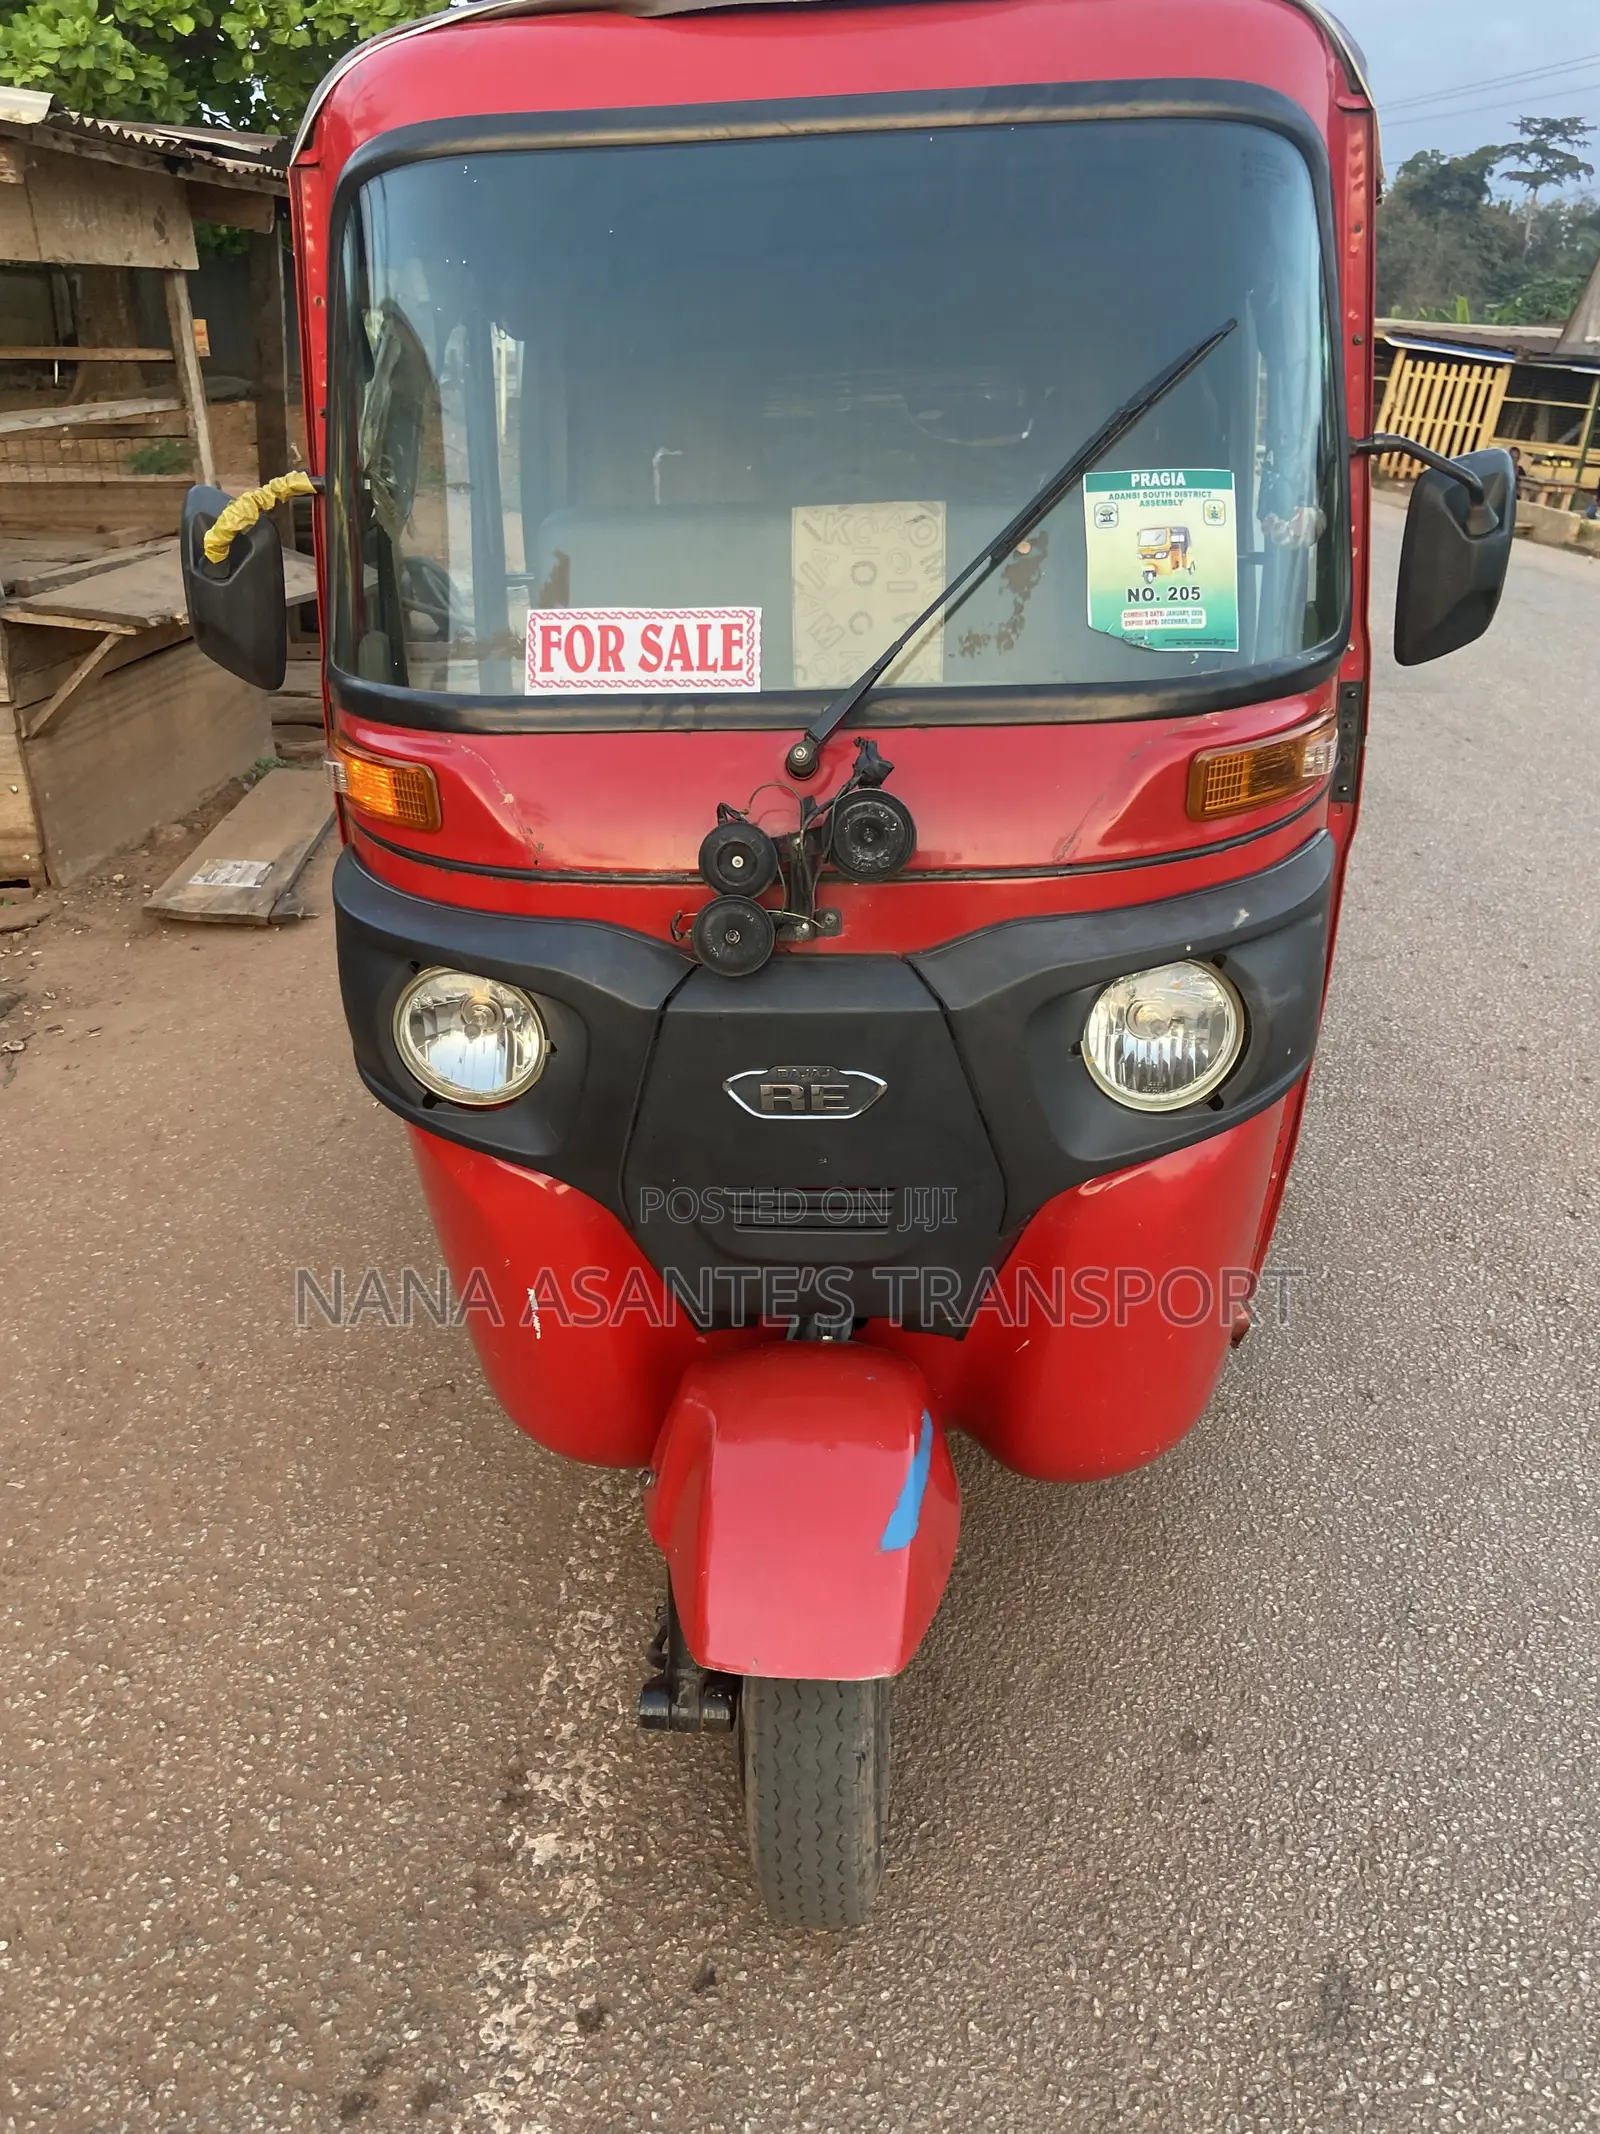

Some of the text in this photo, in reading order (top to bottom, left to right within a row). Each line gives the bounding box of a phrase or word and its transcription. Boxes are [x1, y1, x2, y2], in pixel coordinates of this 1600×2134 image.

[1131, 472, 1186, 487] PRAGIA
[1108, 490, 1212, 500] ADANSI SOUTH DISTRICT
[1139, 499, 1184, 507] ASSEMBLY
[1127, 586, 1201, 602] NO. 205
[539, 623, 744, 674] FOR SALE
[777, 1068, 831, 1078] BAJAJ
[759, 1084, 850, 1111] RE
